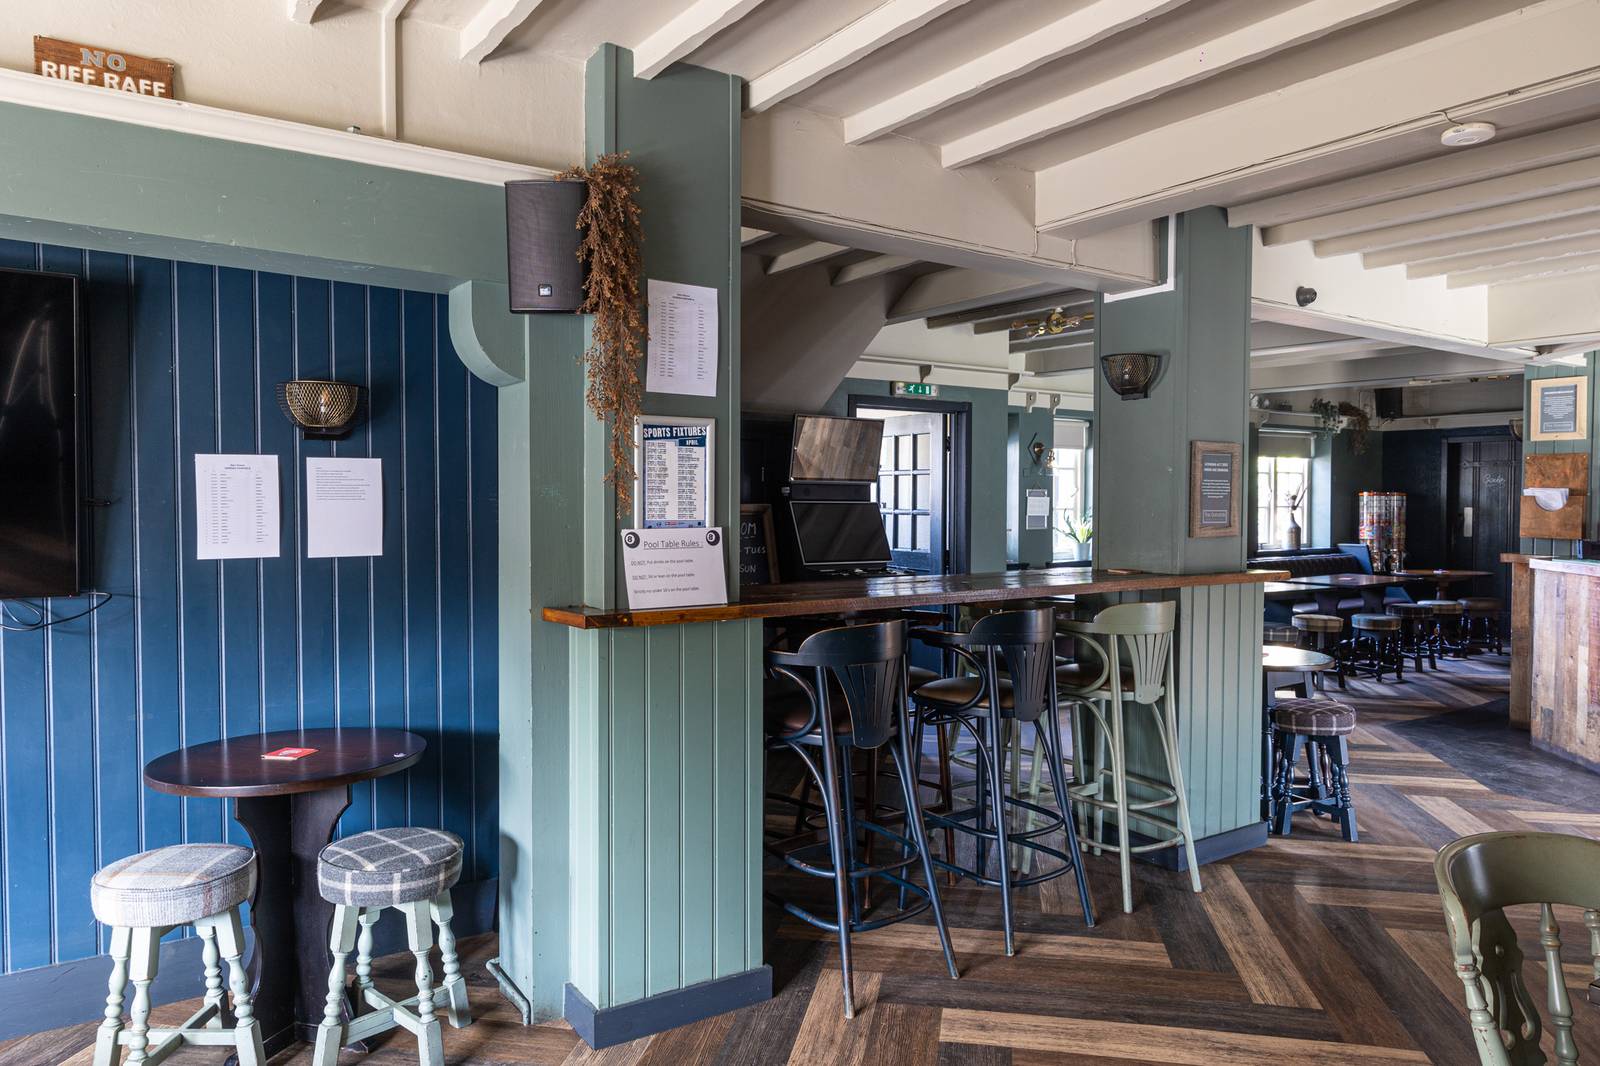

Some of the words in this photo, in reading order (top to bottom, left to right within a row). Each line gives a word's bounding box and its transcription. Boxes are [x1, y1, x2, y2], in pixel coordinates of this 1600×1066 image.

[79, 47, 127, 72] NO
[41, 60, 97, 85] RIFF
[103, 72, 166, 97] RAFF
[643, 427, 671, 438] SPORTS
[672, 426, 707, 437] FIXTURES
[643, 541, 660, 549] Pool
[660, 539, 680, 548] Table
